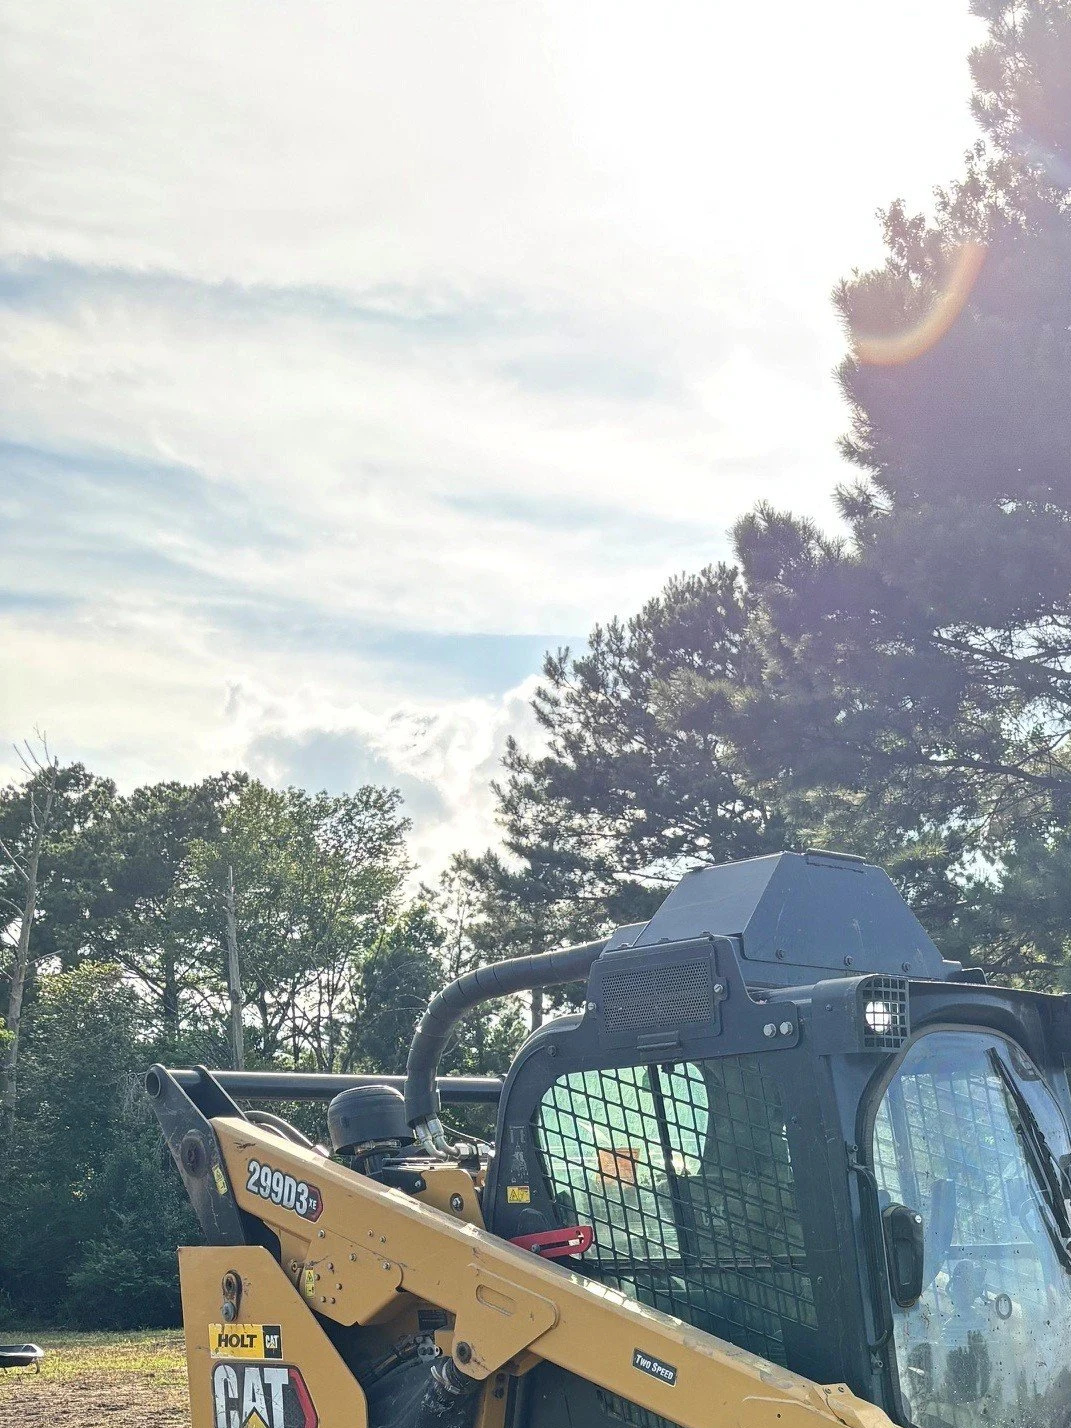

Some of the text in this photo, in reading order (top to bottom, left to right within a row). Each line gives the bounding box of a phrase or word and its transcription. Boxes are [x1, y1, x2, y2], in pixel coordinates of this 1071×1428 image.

[246, 1160, 309, 1215] 299D3
[217, 1333, 279, 1349] HOLT CAT
